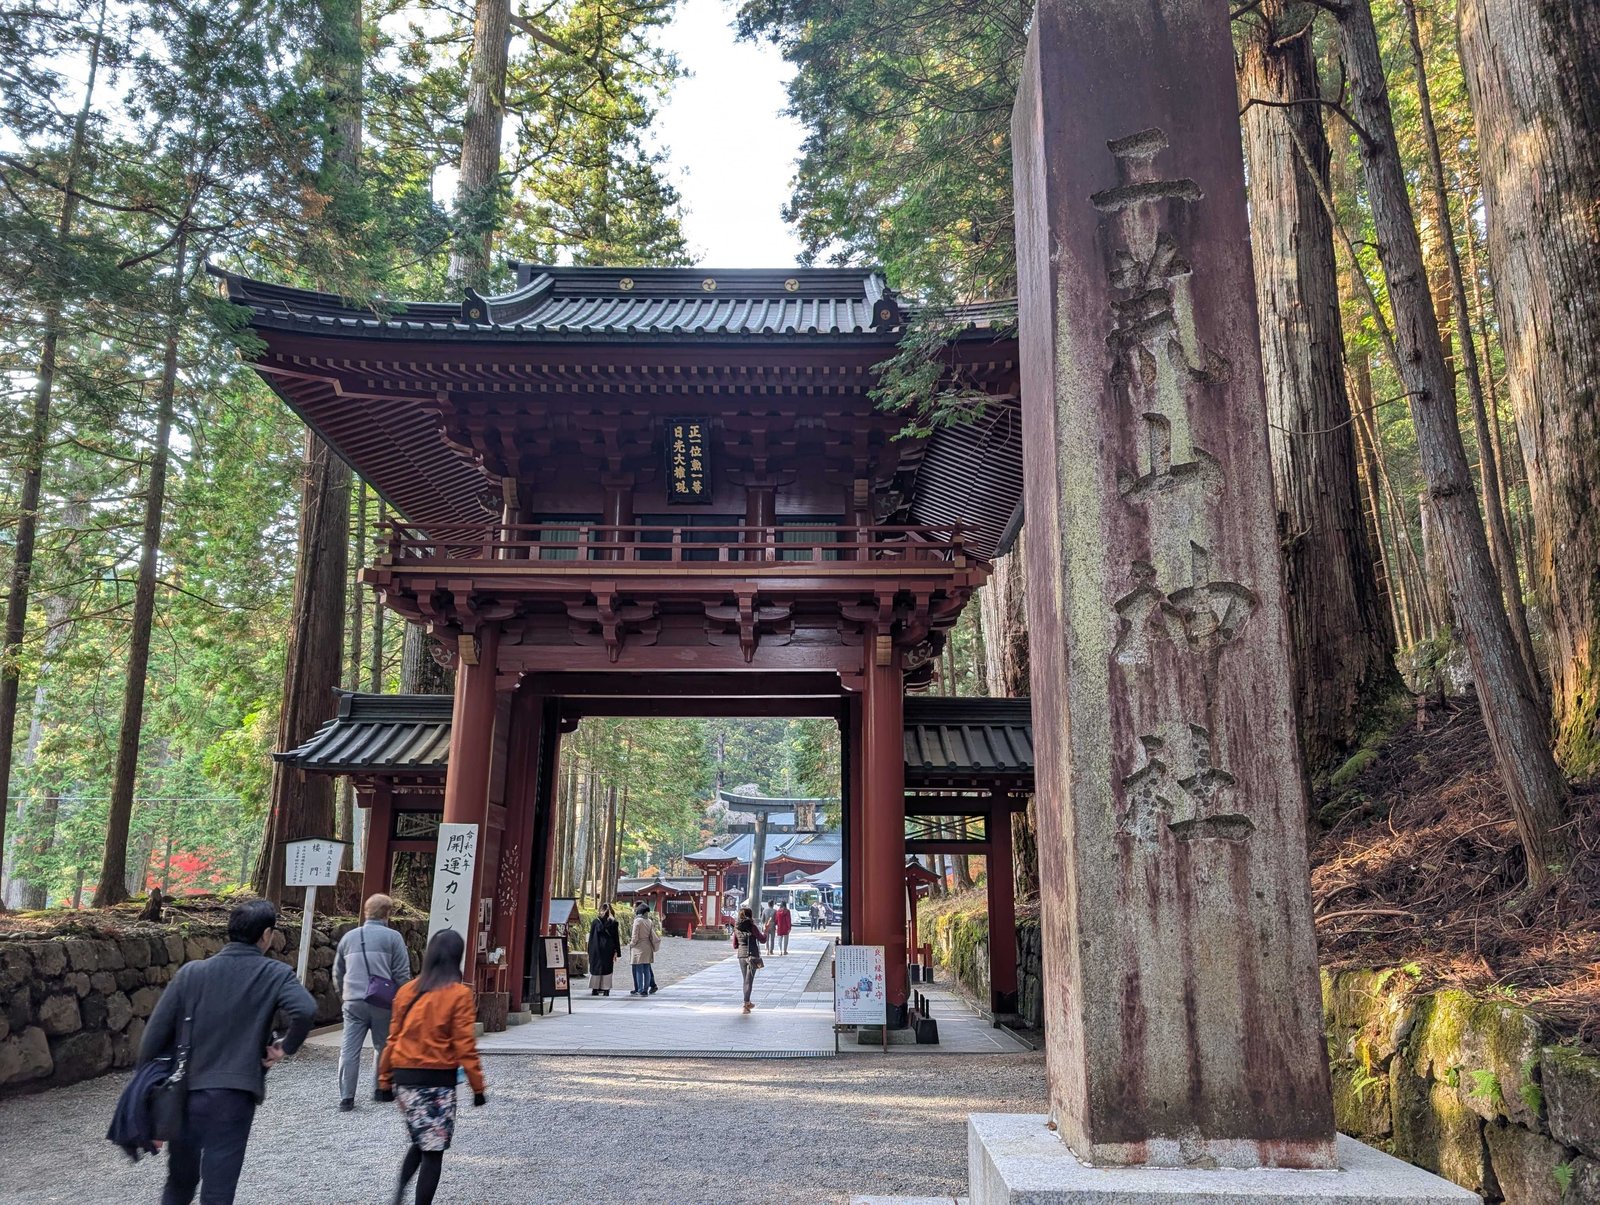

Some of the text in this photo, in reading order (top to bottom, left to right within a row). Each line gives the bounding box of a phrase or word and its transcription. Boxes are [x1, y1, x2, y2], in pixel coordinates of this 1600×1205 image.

[1090, 127, 1256, 843] 二荒山神社
[462, 831, 475, 871] 令和八年
